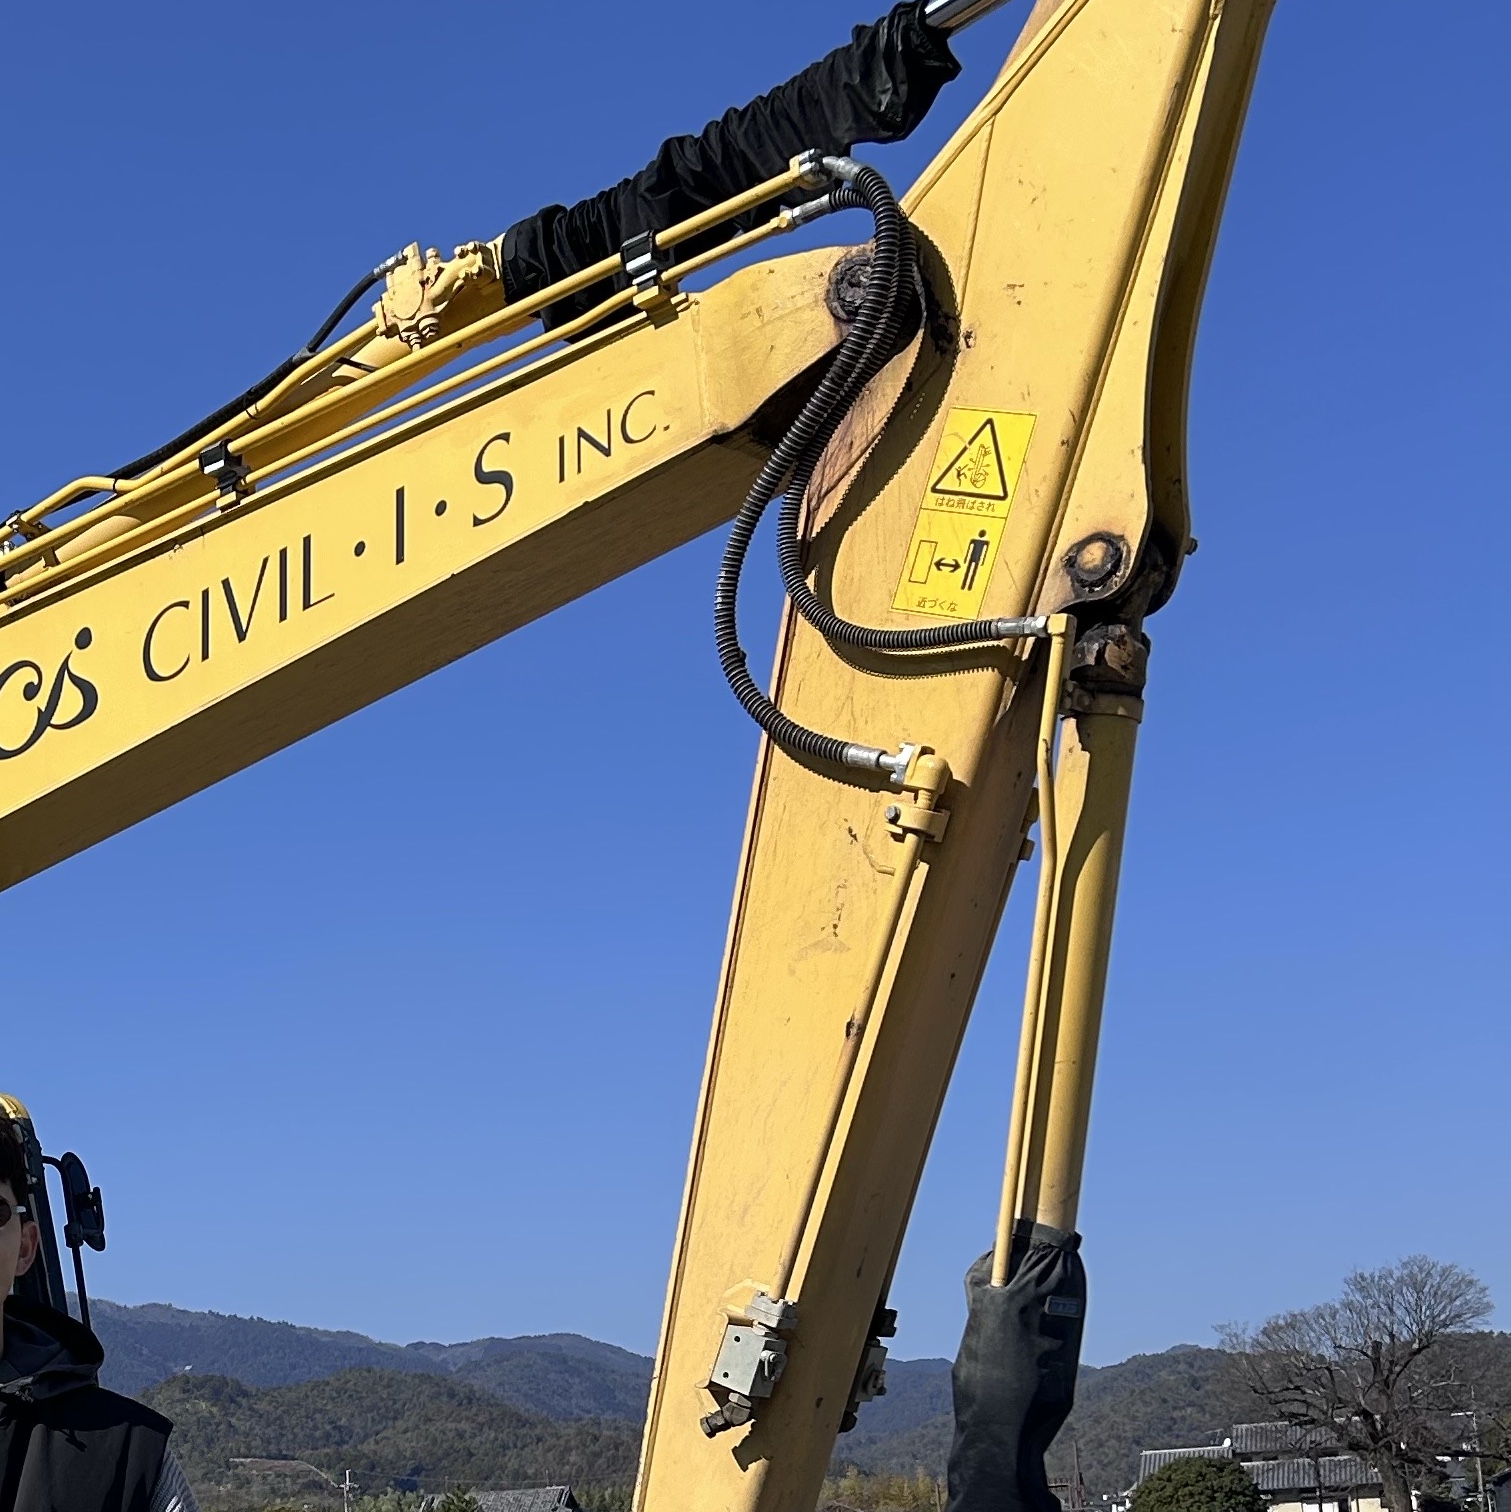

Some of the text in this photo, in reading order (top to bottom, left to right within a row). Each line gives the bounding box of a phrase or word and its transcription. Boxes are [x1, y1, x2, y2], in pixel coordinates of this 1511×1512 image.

[558, 390, 672, 484] INC.
[934, 496, 996, 512] はね飛ばされ
[916, 596, 958, 612] 近づくな
